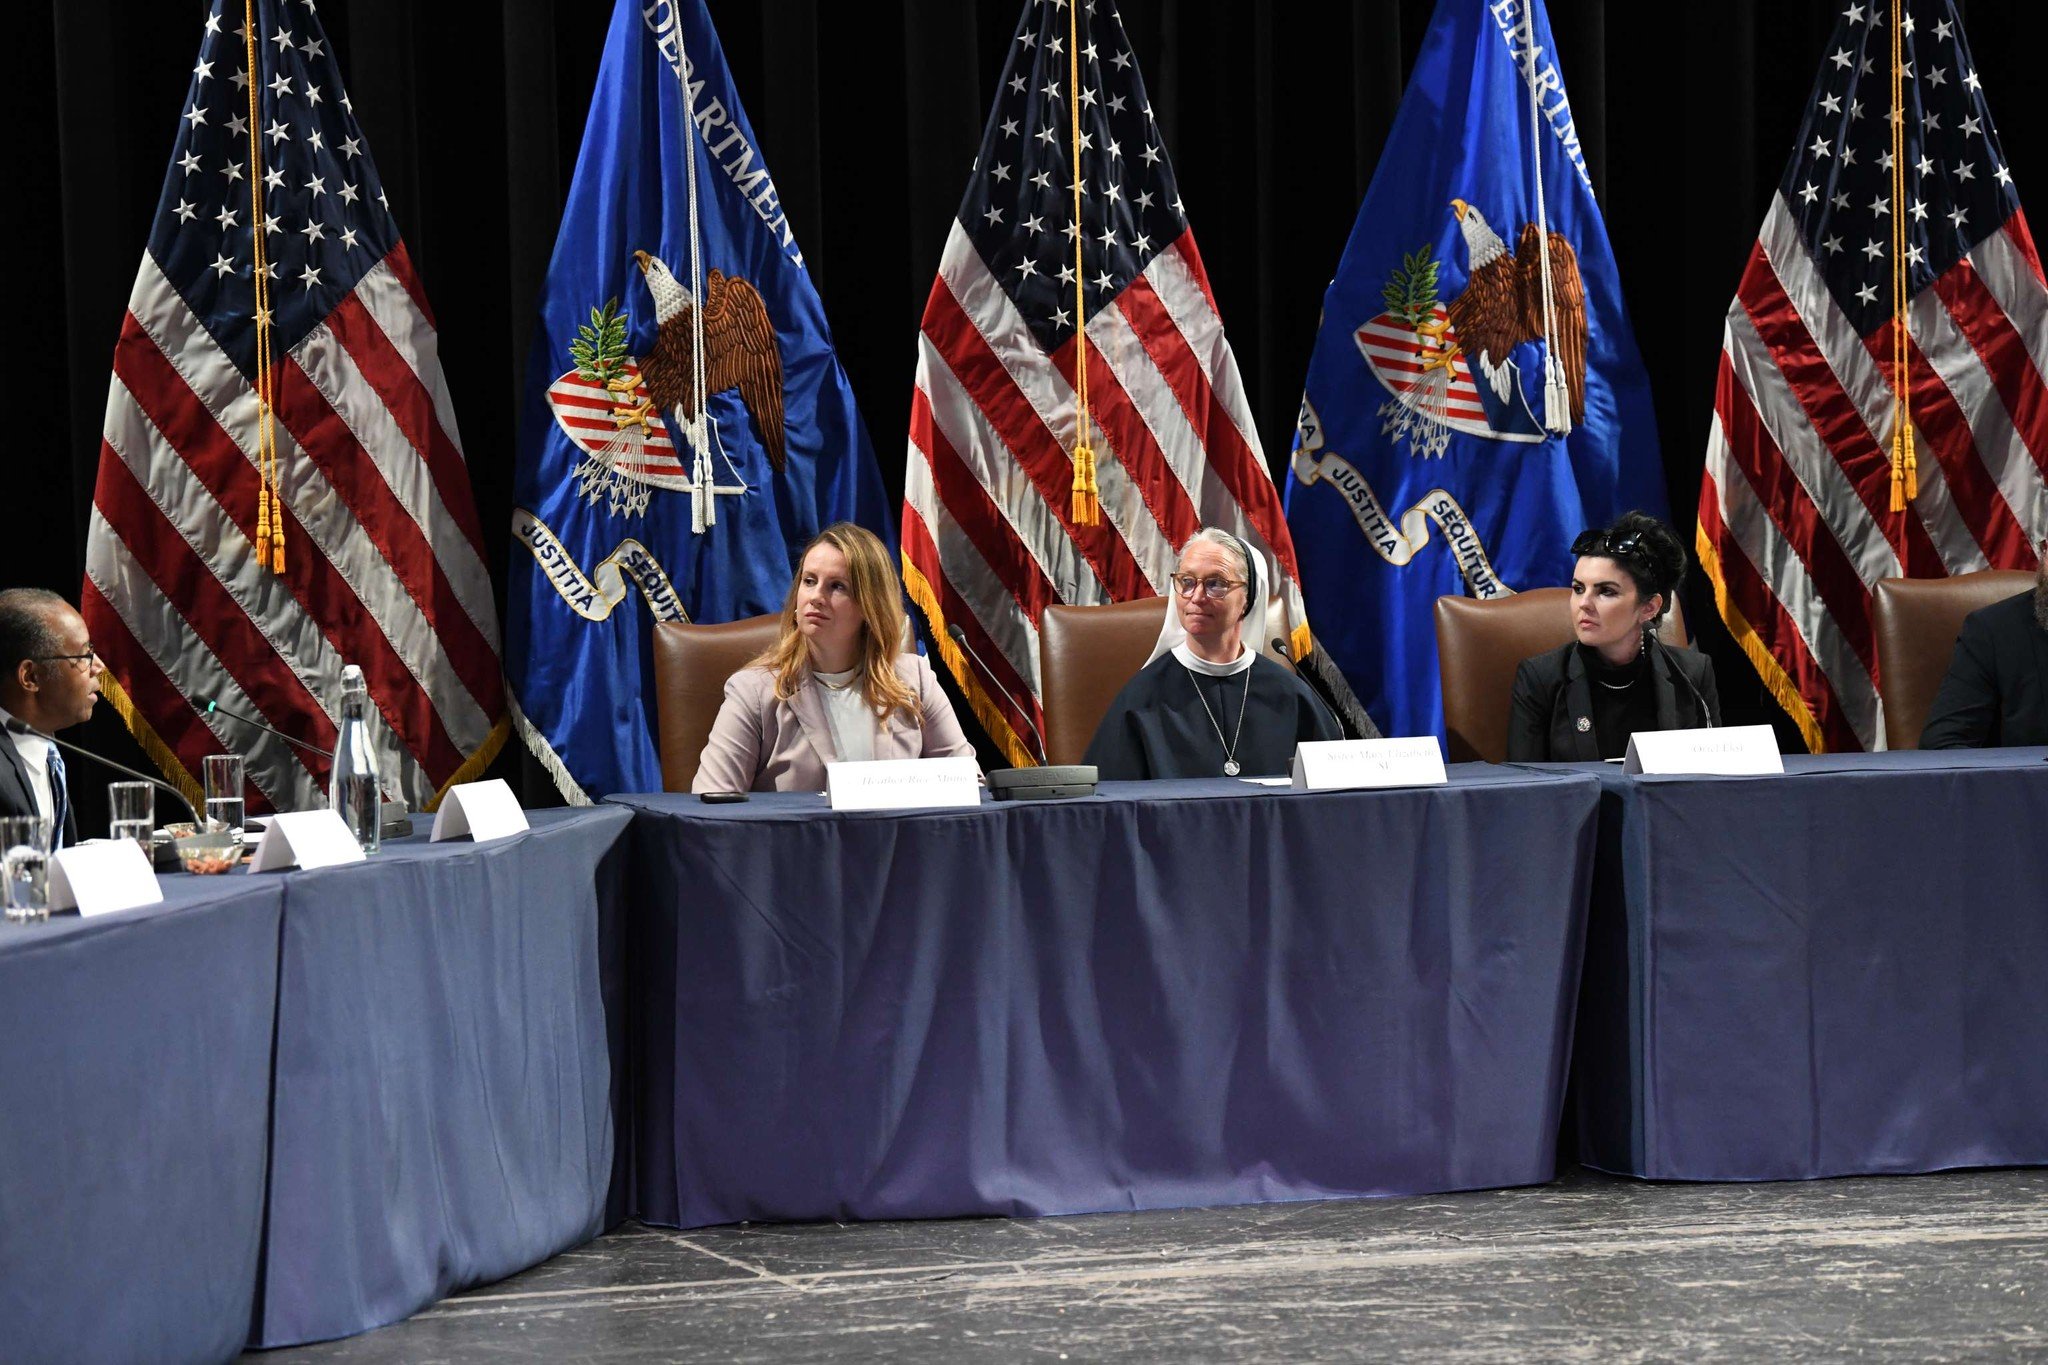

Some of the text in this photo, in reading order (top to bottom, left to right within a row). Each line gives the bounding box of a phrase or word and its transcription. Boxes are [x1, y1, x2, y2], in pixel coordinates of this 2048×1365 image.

[643, 0, 804, 268] DEPARTMEN
[521, 520, 595, 612] JUSTITIA
[1332, 467, 1399, 556] JUSTITIA
[1433, 499, 1497, 598] SEQUITUR
